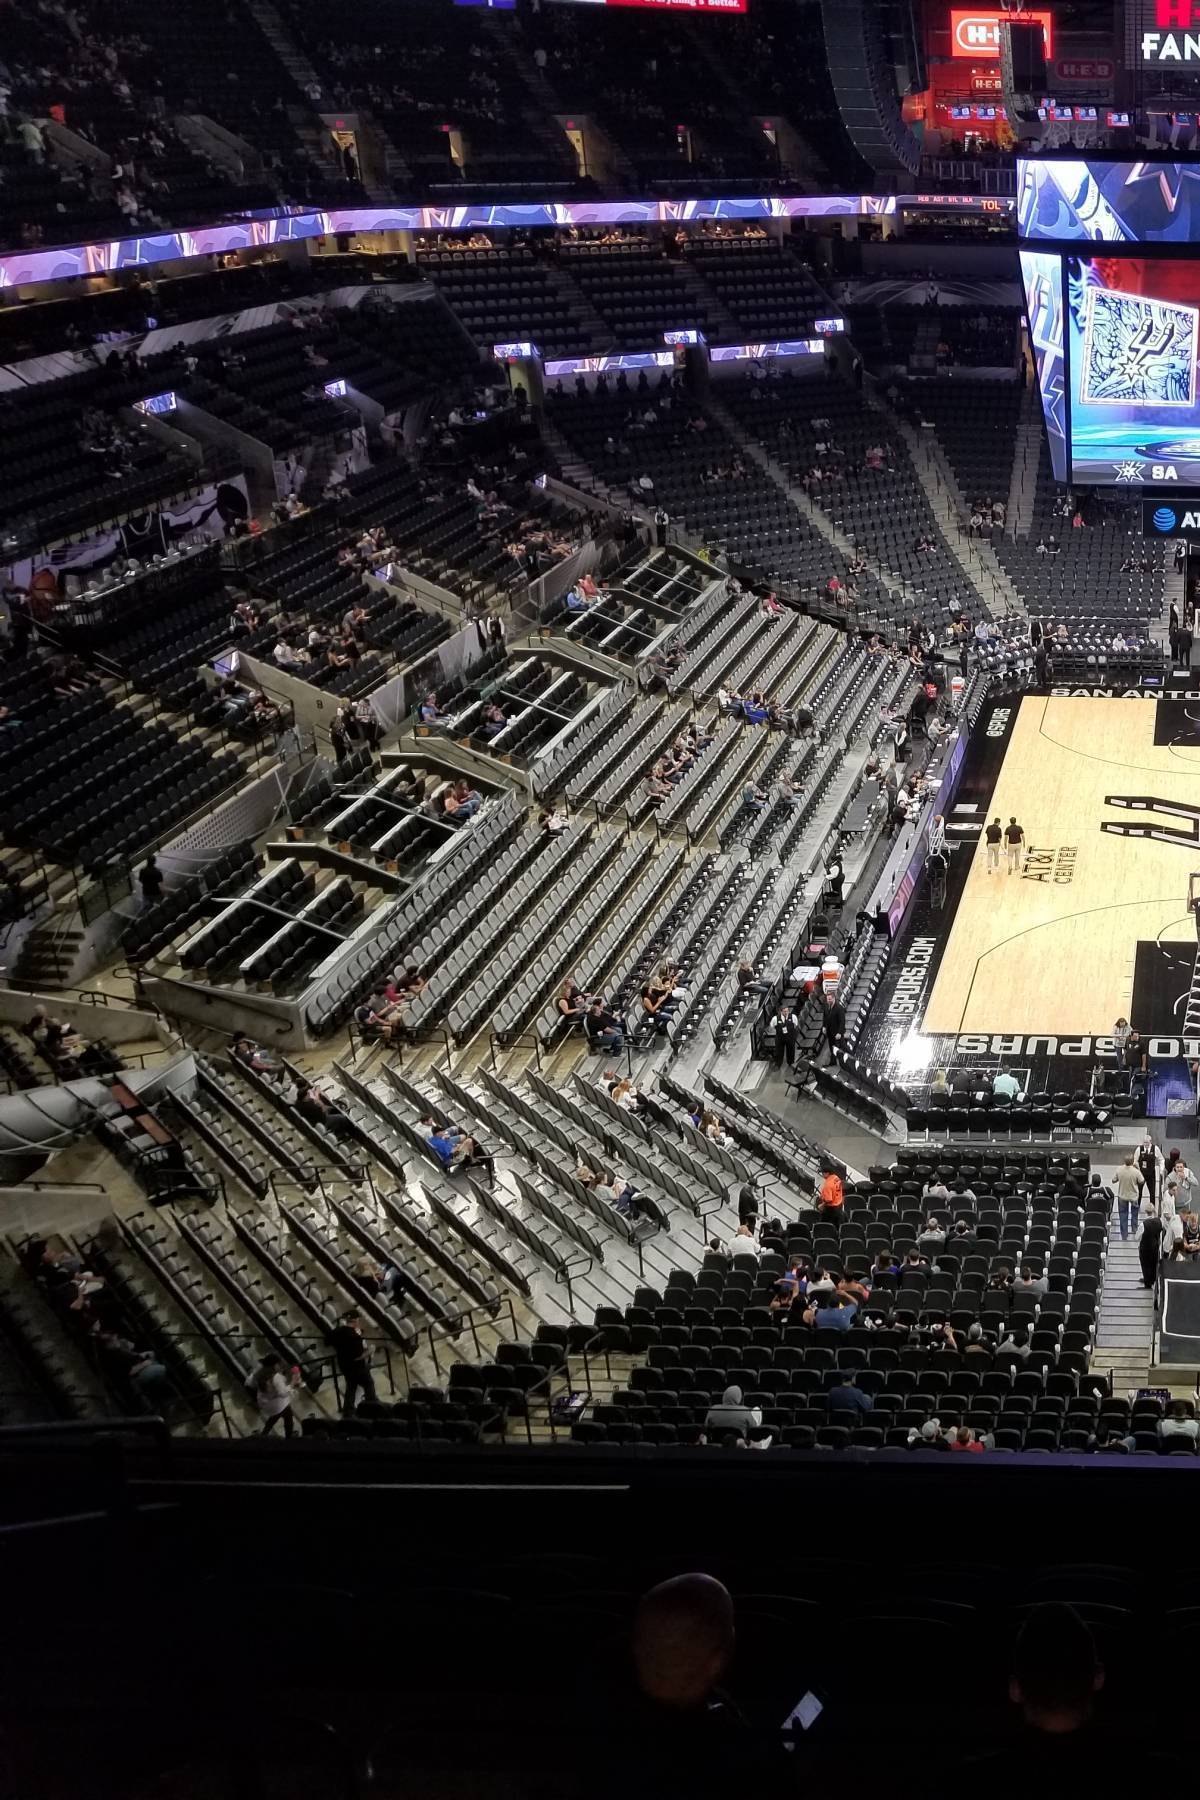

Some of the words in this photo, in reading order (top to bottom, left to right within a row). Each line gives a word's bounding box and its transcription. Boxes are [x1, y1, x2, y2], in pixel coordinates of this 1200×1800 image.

[981, 200, 1001, 210] TOL
[1007, 201, 1015, 211] 7
[1152, 465, 1178, 481] SA
[1050, 688, 1113, 698] SAN
[985, 707, 1012, 737] @SPURS
[1021, 846, 1055, 884] AT&T
[1054, 846, 1078, 885] CENTER
